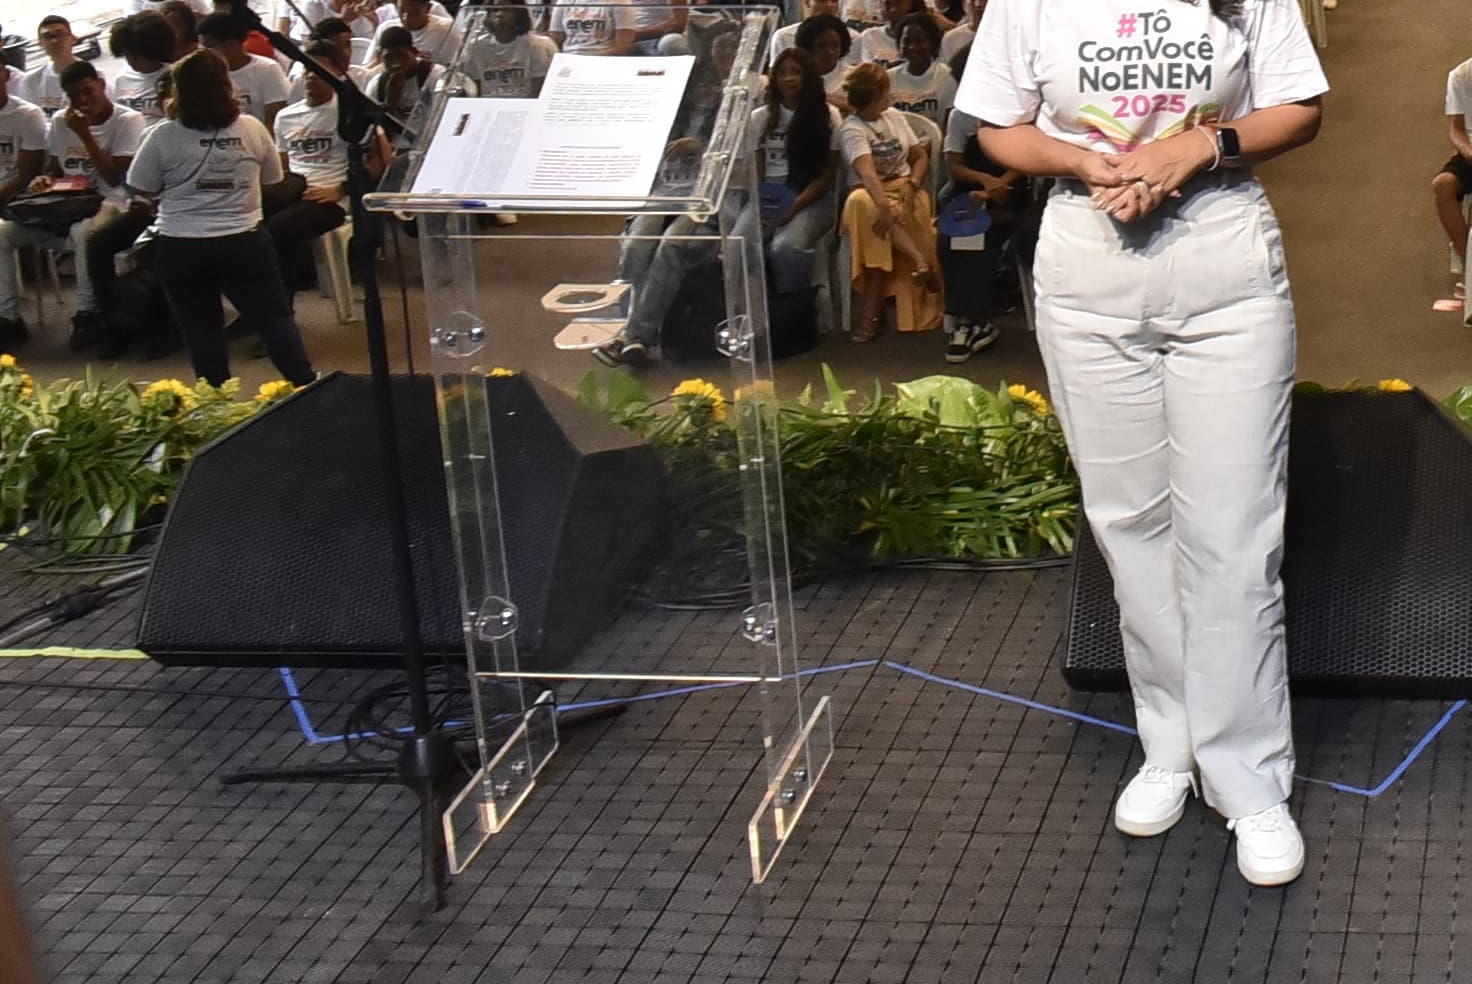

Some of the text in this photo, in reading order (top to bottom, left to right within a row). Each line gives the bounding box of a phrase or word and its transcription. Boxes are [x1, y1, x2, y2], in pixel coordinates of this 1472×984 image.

[1116, 9, 1171, 38] #Tô
[1078, 33, 1214, 62] ComVocê
[1079, 63, 1212, 93] NoENEM
[1111, 93, 1187, 118] 2025
